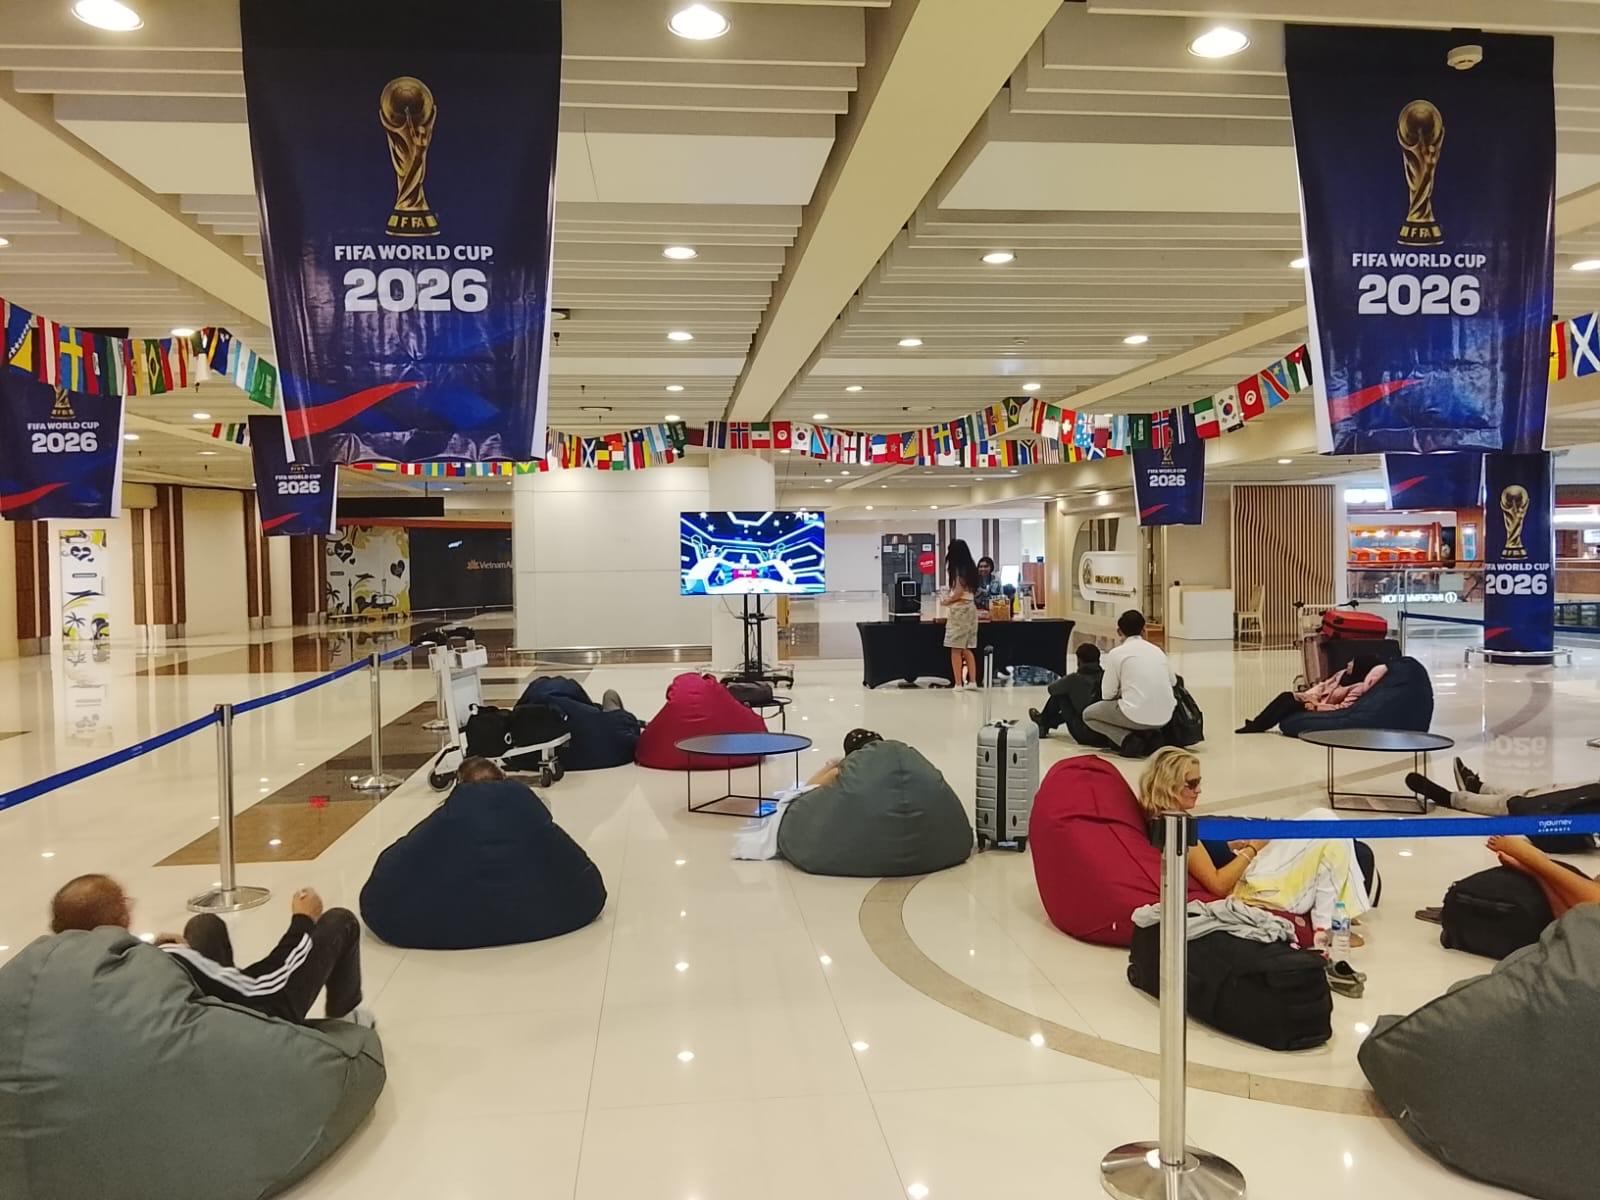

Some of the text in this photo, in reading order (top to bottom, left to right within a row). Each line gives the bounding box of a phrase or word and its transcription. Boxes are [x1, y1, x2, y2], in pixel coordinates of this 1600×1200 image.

[334, 245, 494, 261] FIFA WORLD CUP
[1352, 253, 1487, 268] FIFA WORLD CUP
[343, 267, 489, 312] 2026
[1358, 273, 1481, 315] 2026
[27, 421, 100, 430] FIFA WORLD CUP
[31, 431, 98, 453] 2026
[277, 480, 321, 494] 2026
[1149, 474, 1186, 487] 2026
[1497, 563, 1532, 571] WORLD
[1533, 563, 1550, 571] CUP
[1485, 573, 1548, 595] 2026
